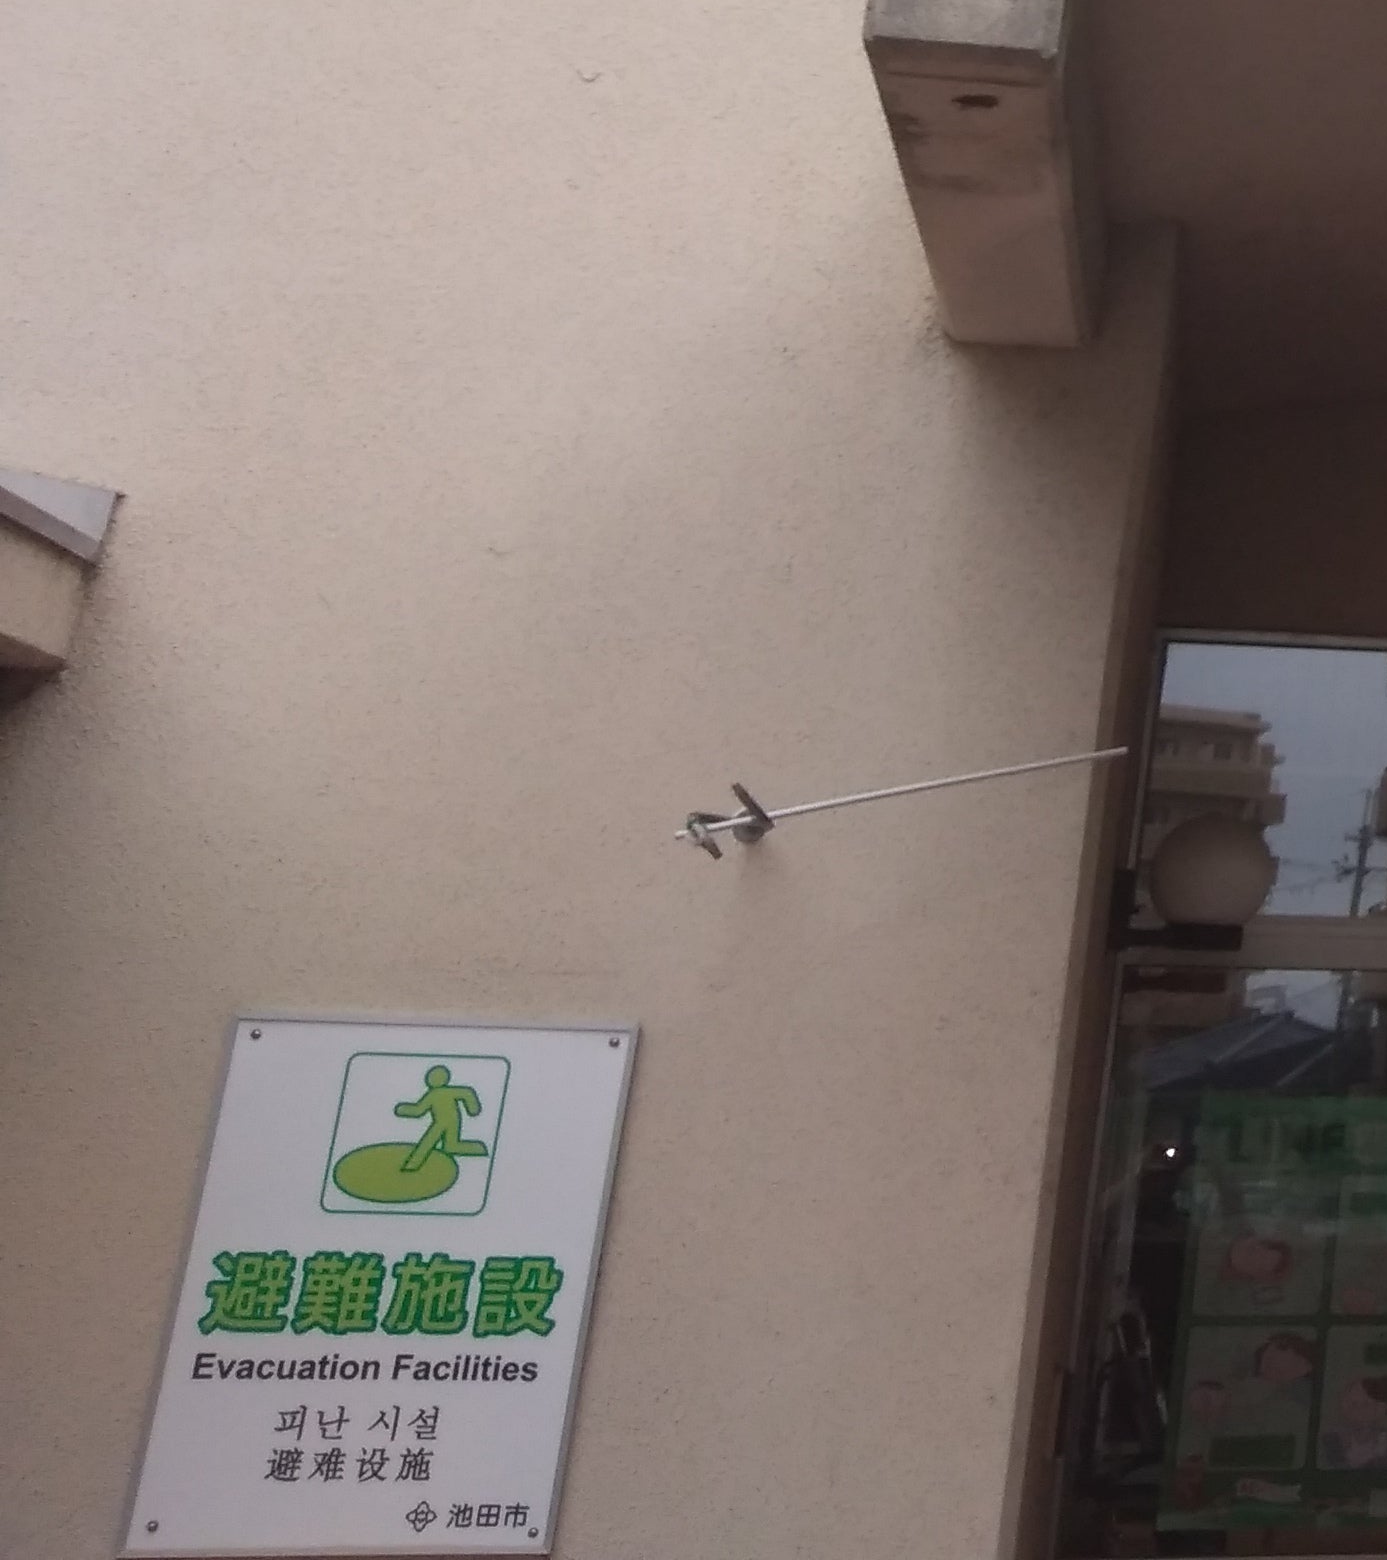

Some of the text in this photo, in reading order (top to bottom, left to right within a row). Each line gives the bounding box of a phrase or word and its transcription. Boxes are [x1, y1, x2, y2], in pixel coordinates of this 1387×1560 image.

[198, 1250, 563, 1338] 避難施設
[192, 1353, 539, 1383] Evacuation Facilities
[273, 1405, 441, 1441] 피난 시설
[264, 1447, 434, 1482] 避难设施
[445, 1501, 531, 1530] 池田市
